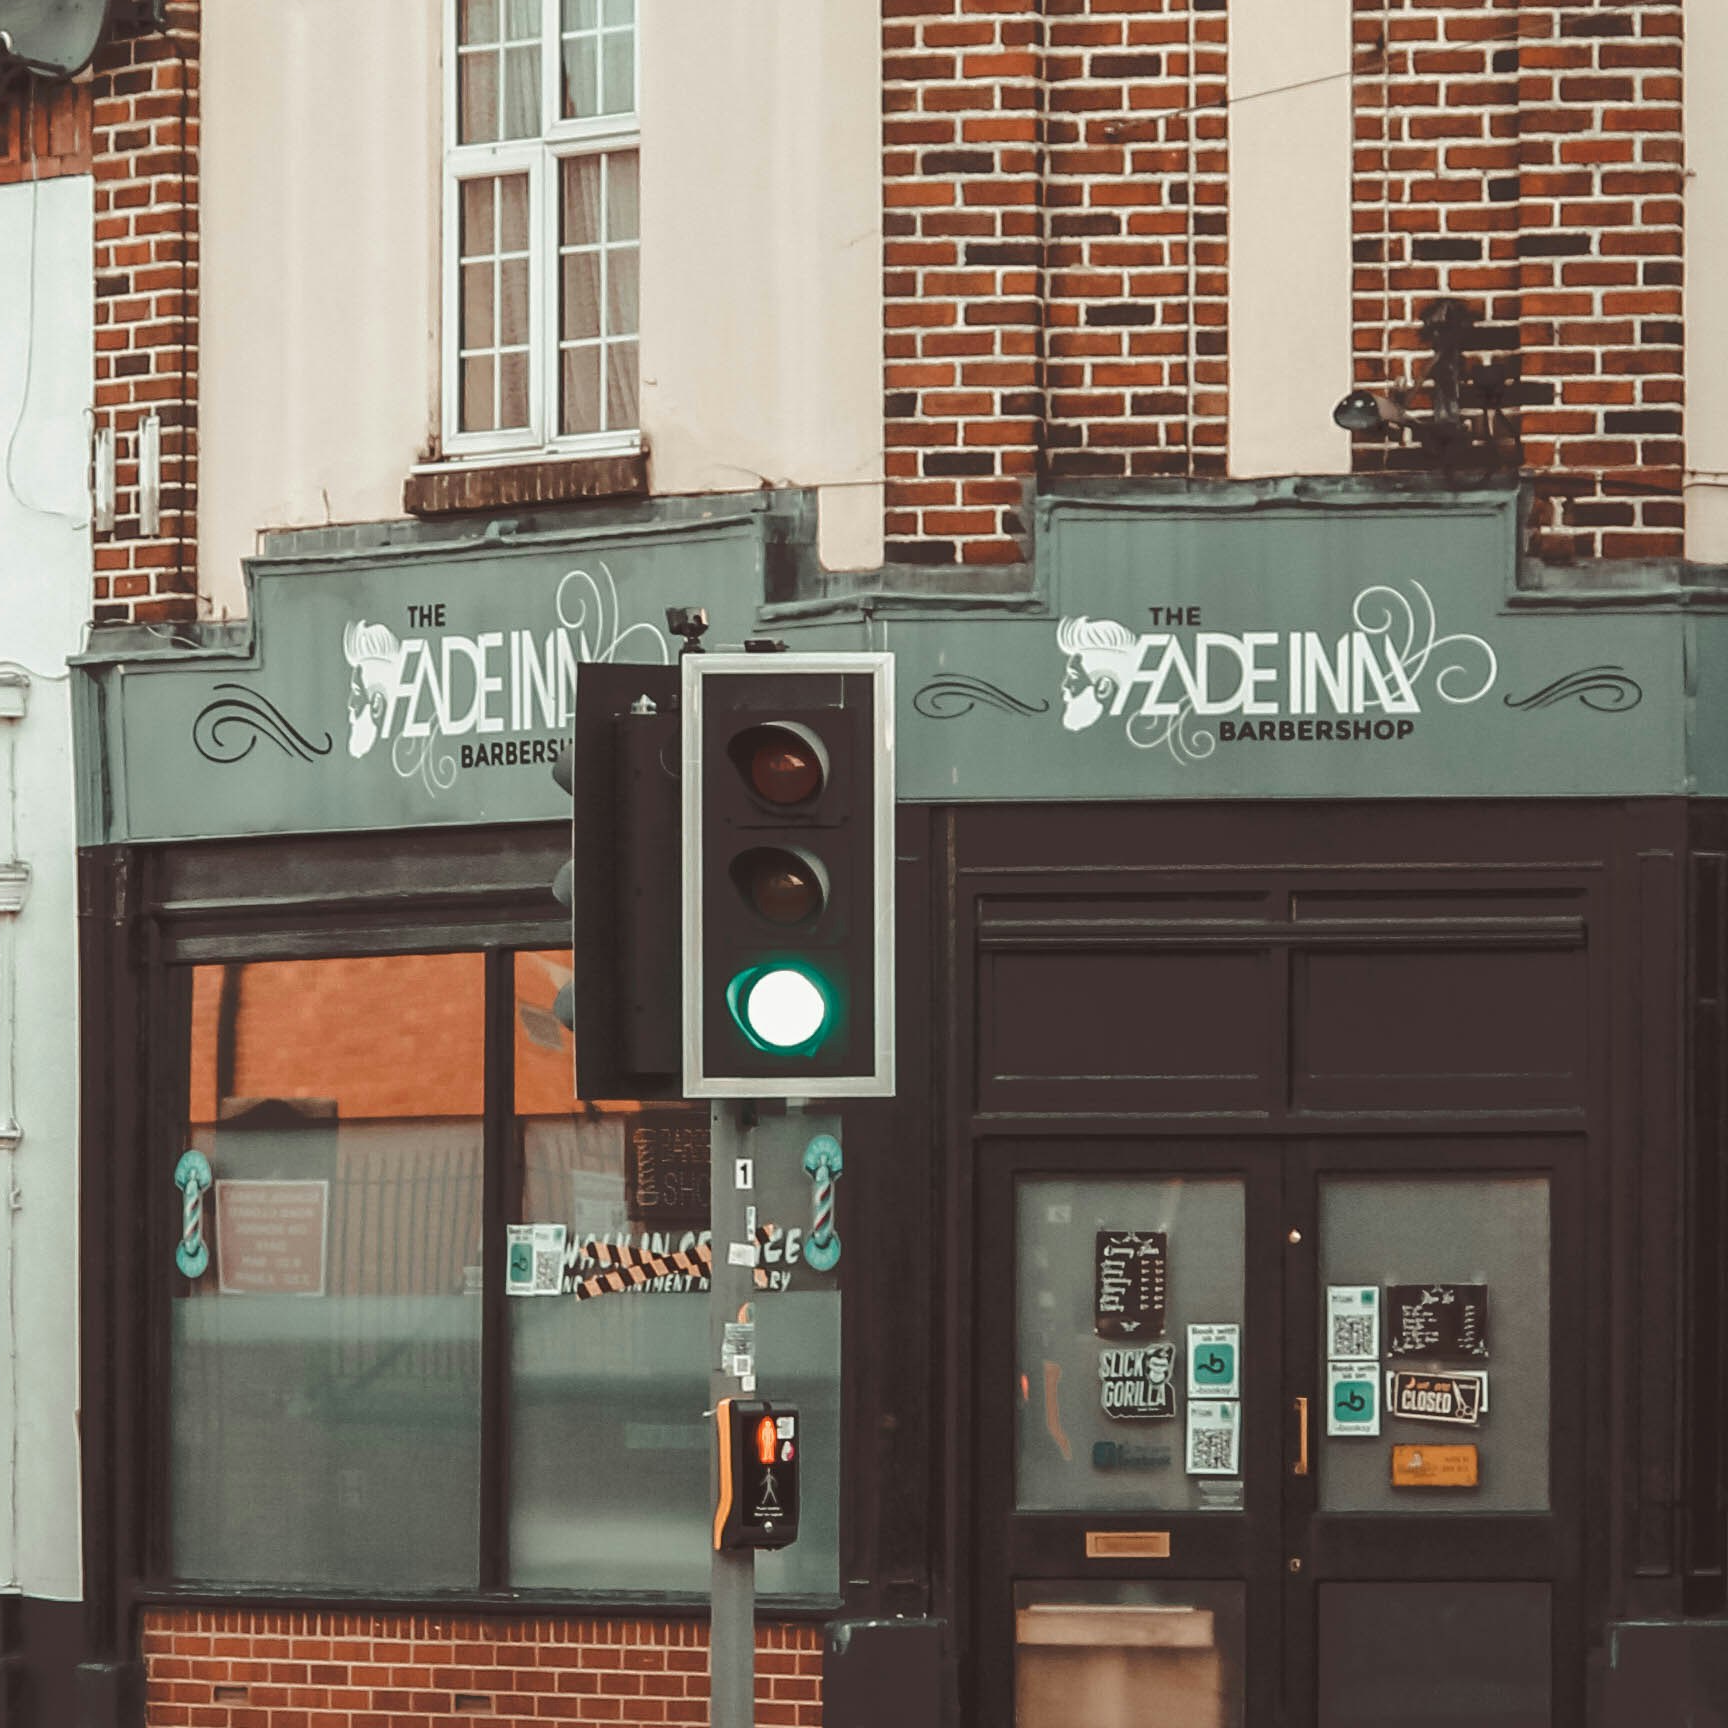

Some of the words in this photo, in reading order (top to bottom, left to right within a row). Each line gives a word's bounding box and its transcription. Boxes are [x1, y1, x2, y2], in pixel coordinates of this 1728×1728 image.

[407, 603, 447, 628] THE
[1149, 606, 1201, 627] THE
[1219, 719, 1415, 742] BARBERSHOP
[460, 738, 574, 769] BARBERS
[739, 1163, 749, 1186] 1
[1100, 1350, 1145, 1379] SLICK
[1103, 1380, 1167, 1408] GORILLA
[1401, 1389, 1452, 1414] CLOSED
